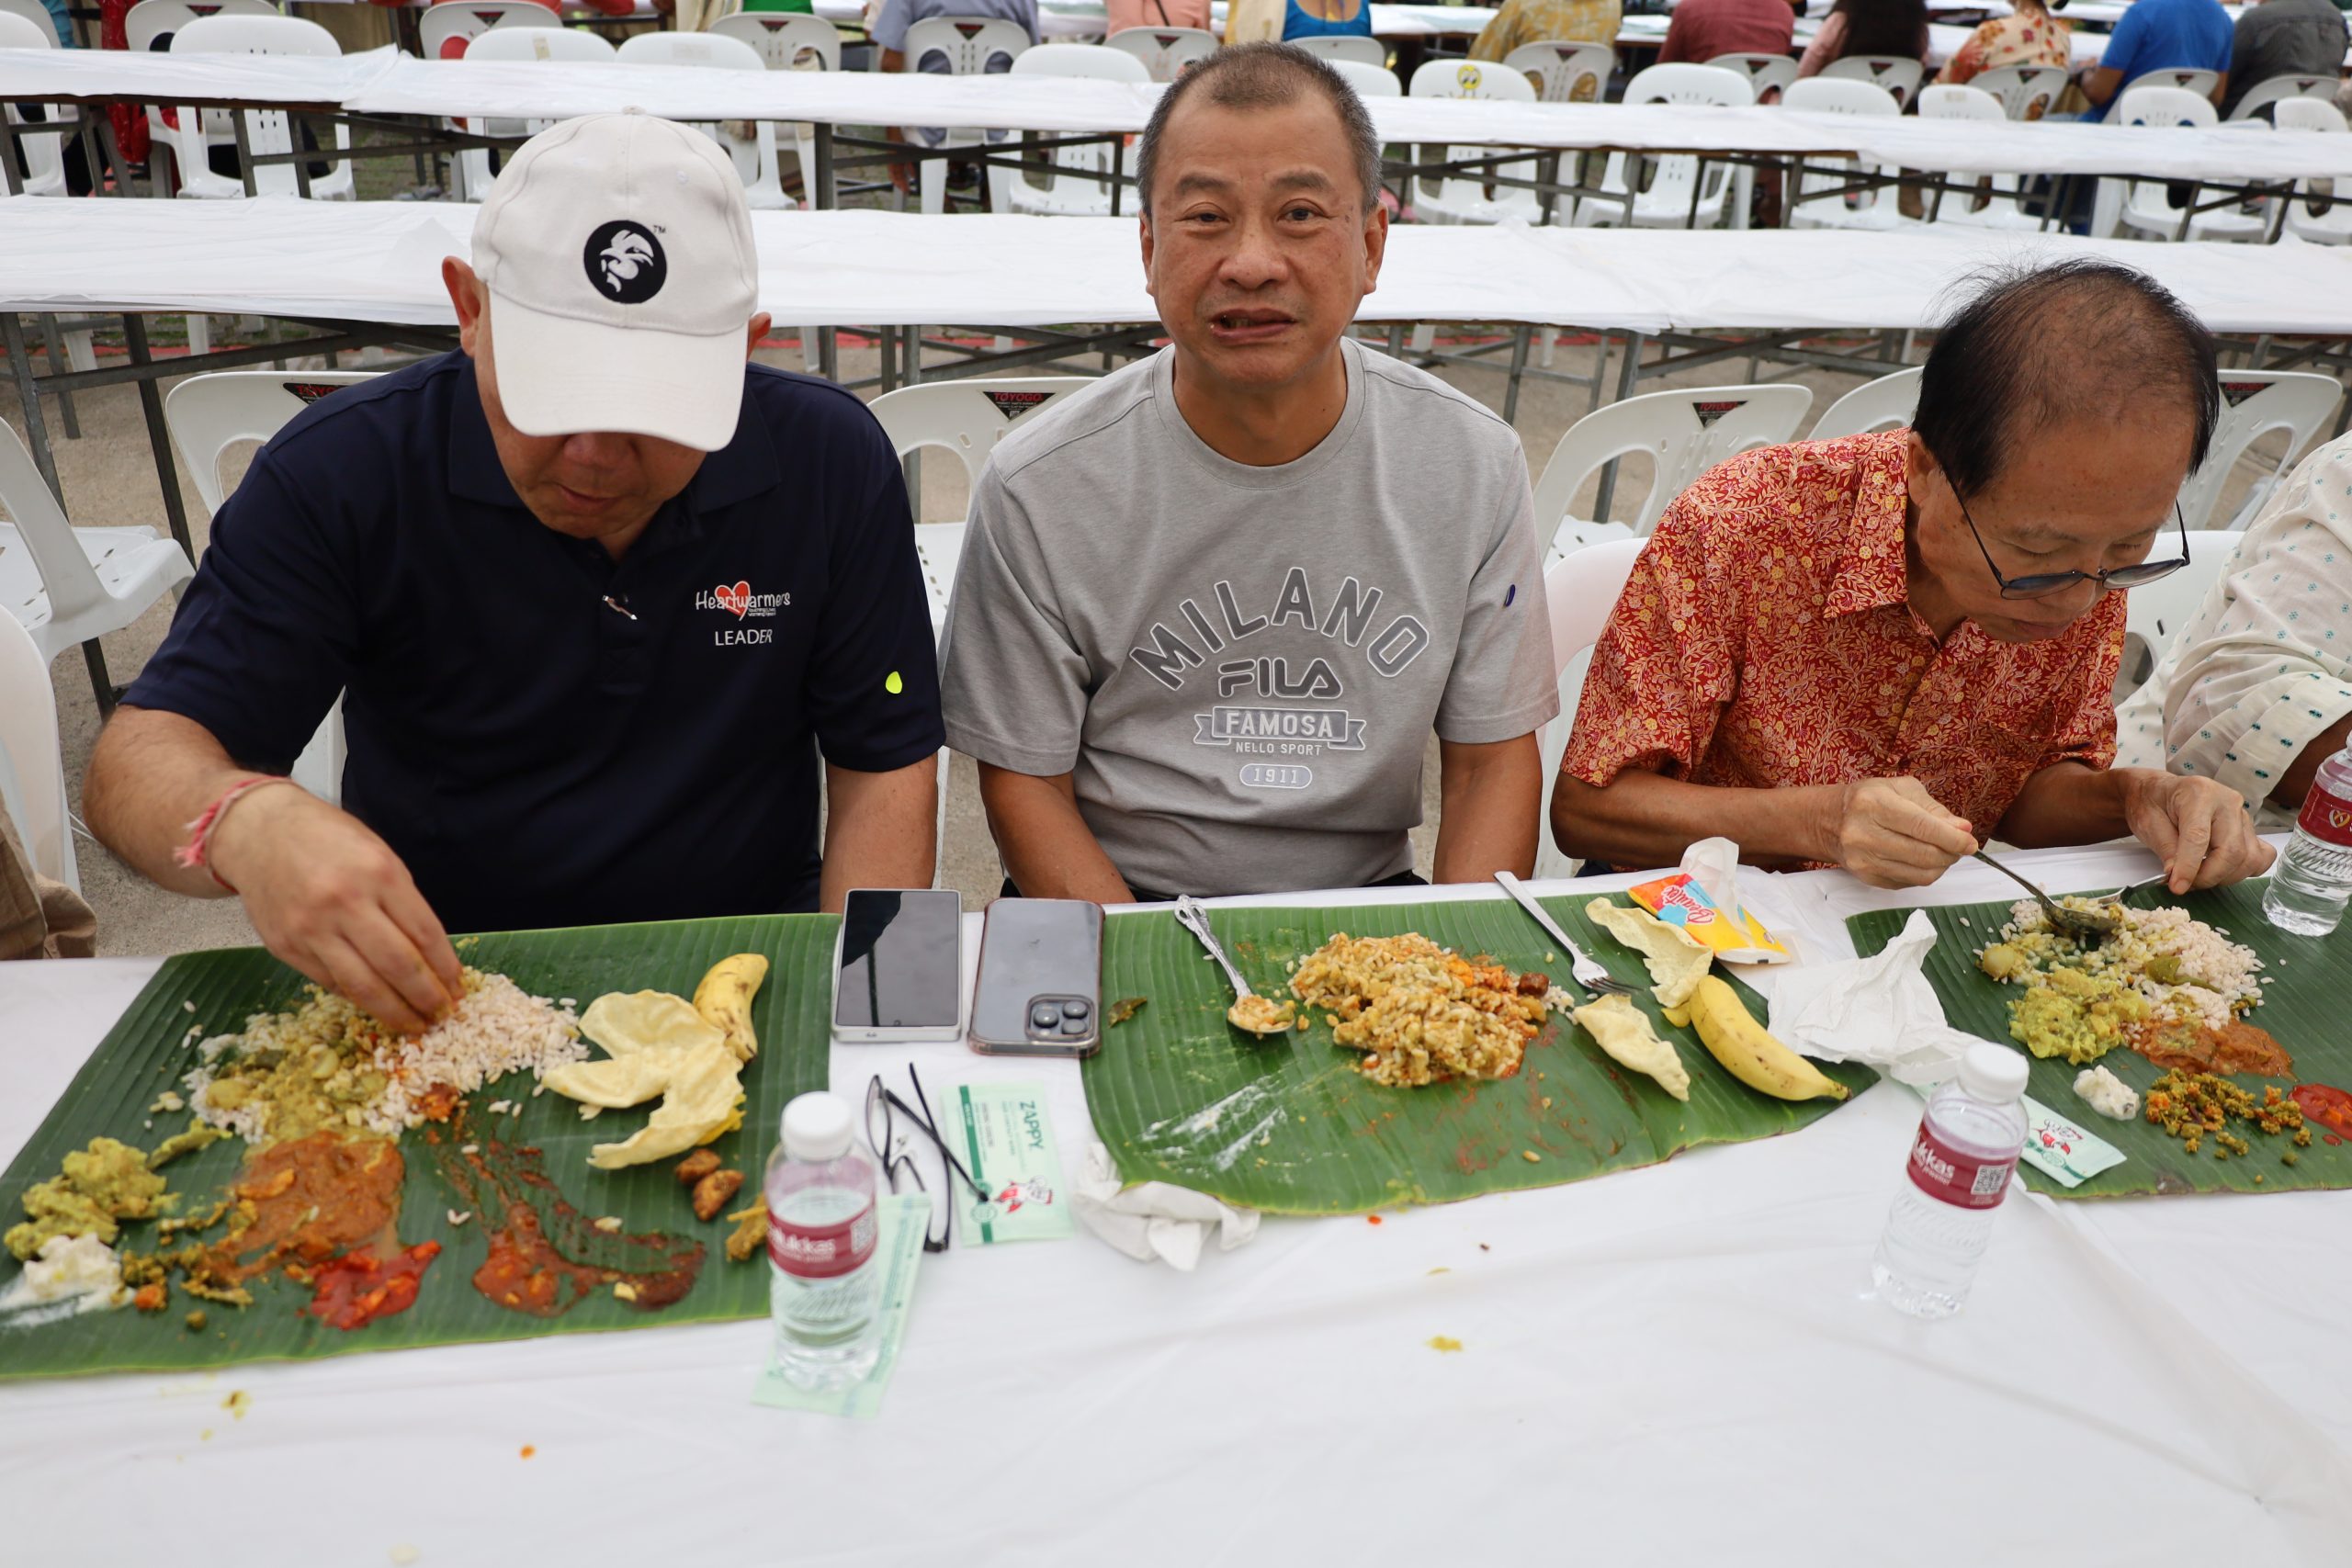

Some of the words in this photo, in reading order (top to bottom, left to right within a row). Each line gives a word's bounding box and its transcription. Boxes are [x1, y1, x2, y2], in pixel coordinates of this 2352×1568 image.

[994, 392, 1044, 402] TOYOGO
[715, 629, 773, 647] LEADER
[1129, 567, 1429, 691] MILANO
[1218, 657, 1343, 699] FILA
[1226, 712, 1333, 738] FAMOSA
[1236, 741, 1274, 754] NELLO
[1281, 743, 1322, 756] SPORT
[1253, 767, 1298, 784] 1911
[1666, 886, 1715, 924] Beautex
[1019, 1100, 1045, 1150] ZAPPY
